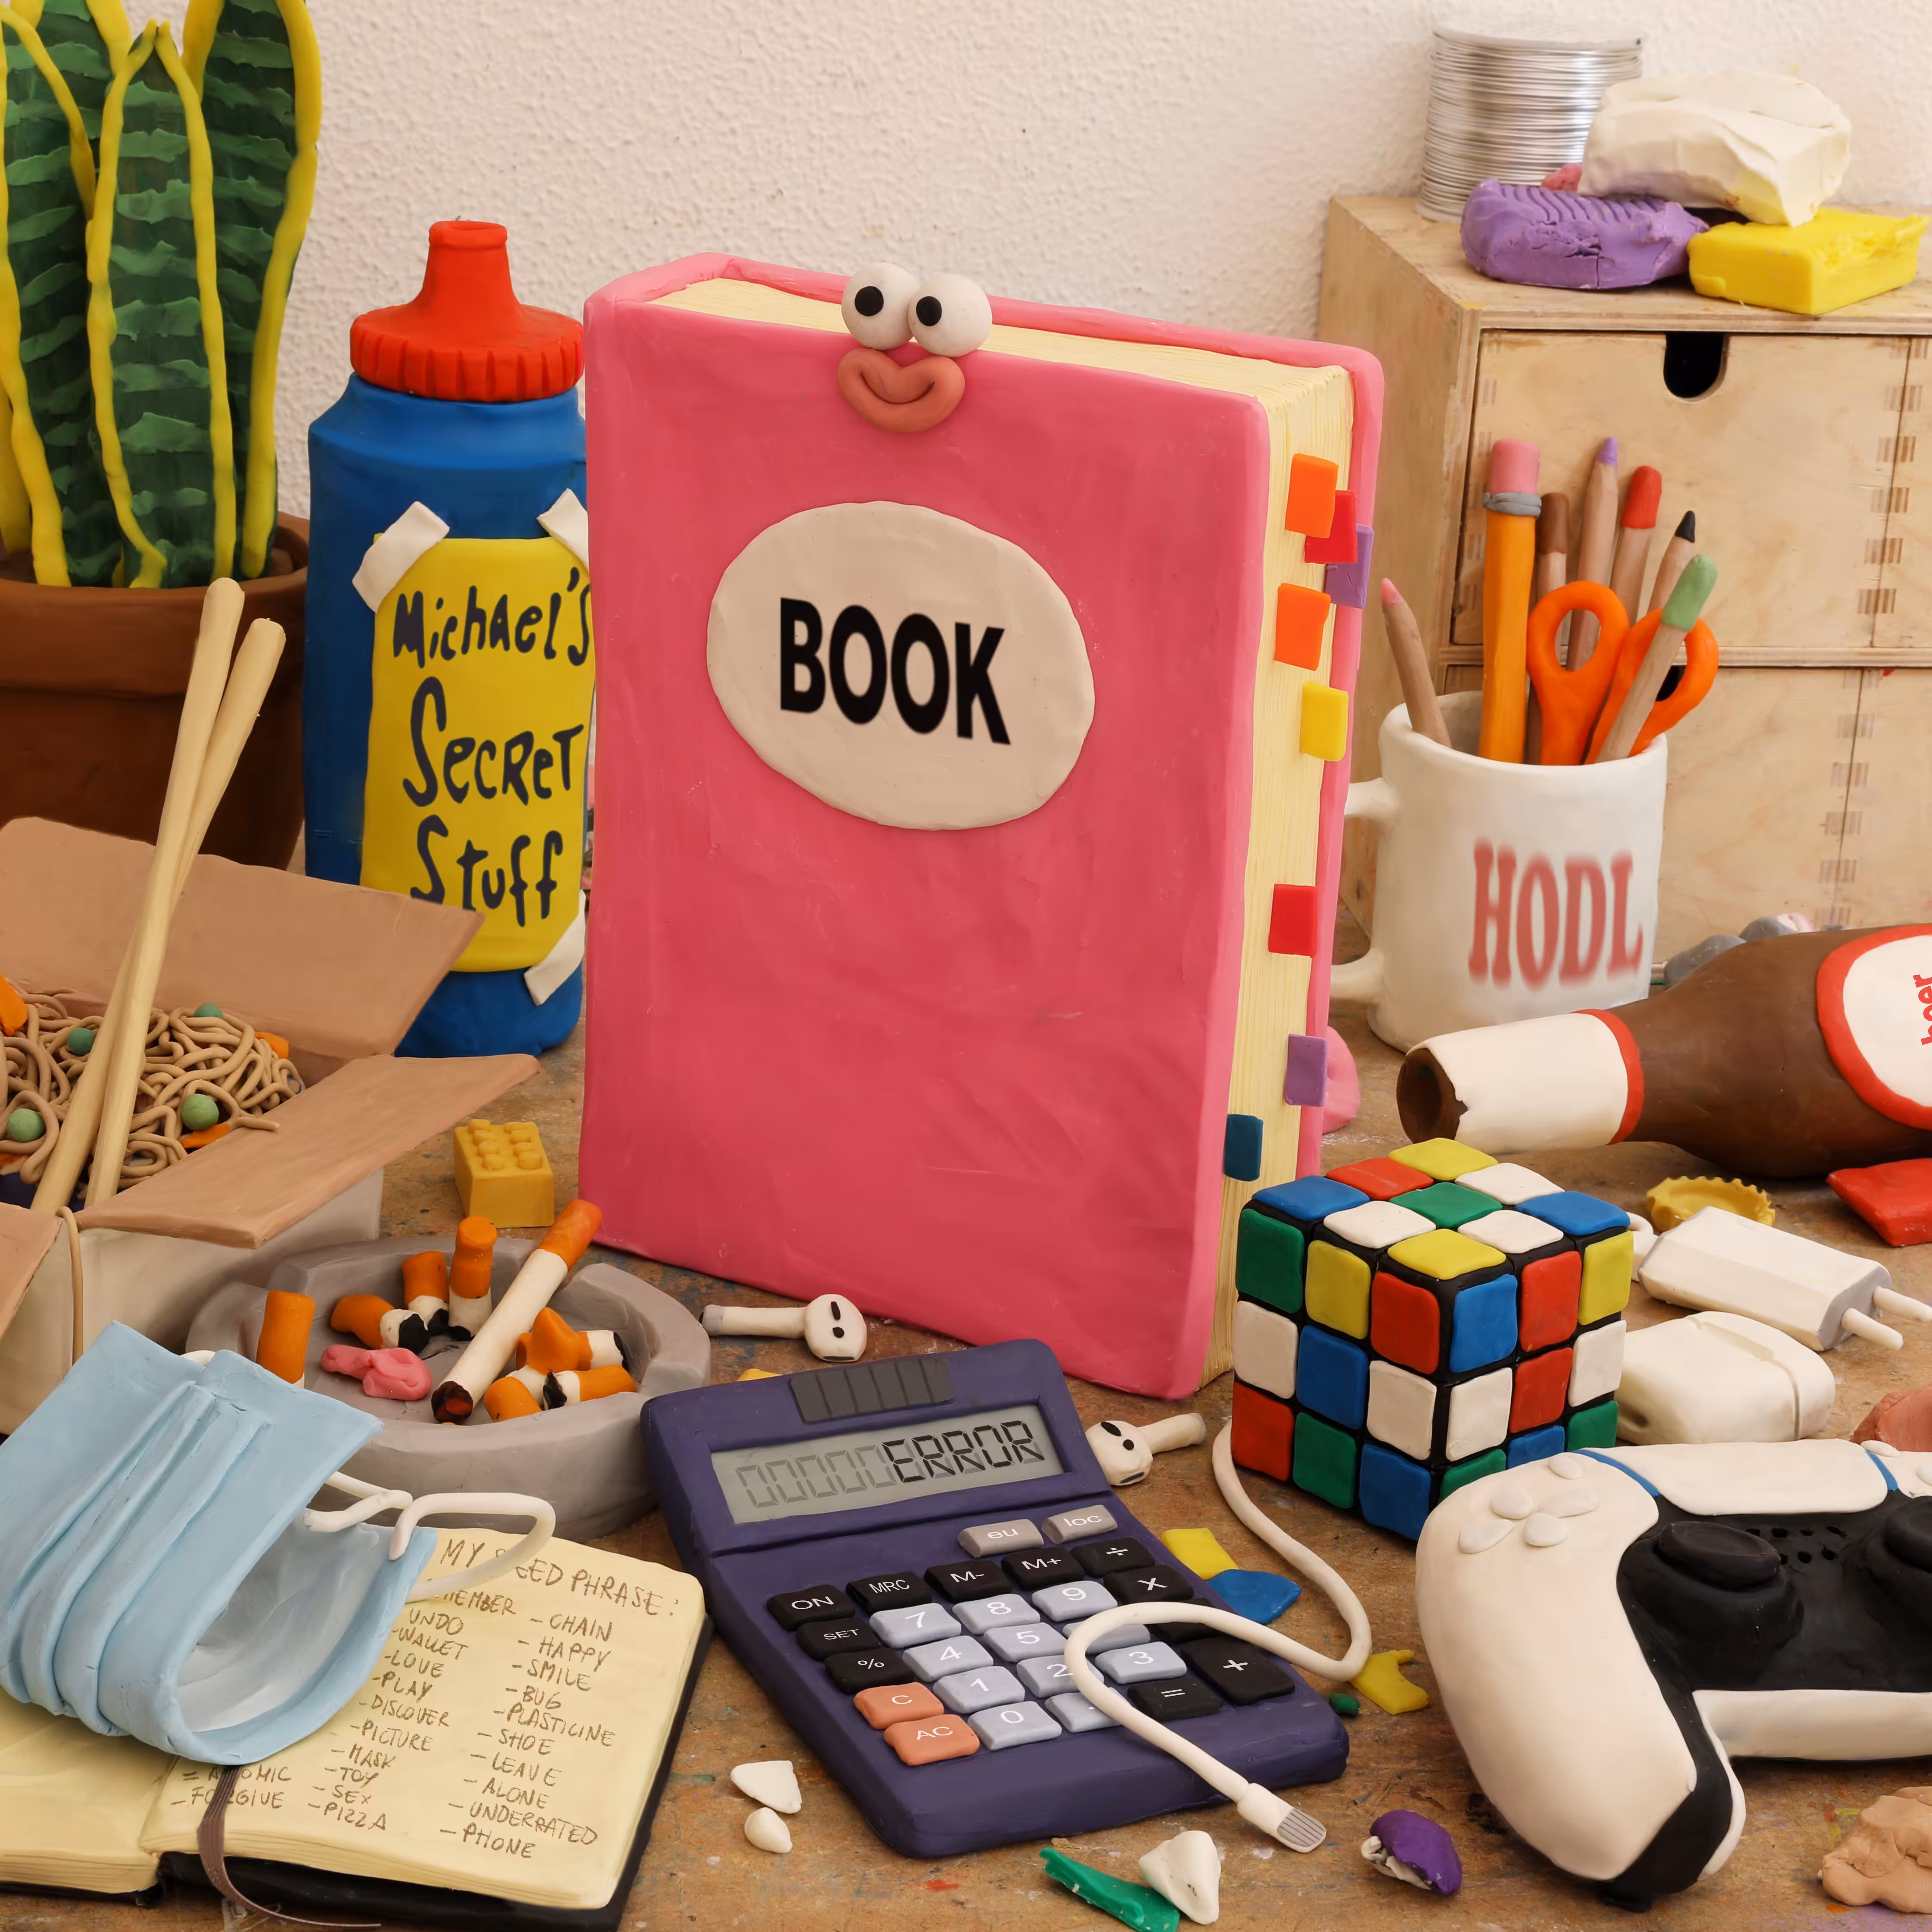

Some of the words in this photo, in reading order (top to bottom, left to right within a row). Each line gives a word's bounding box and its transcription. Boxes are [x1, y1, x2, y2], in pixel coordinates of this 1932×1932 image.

[780, 597, 1010, 745] BOOK
[410, 814, 562, 927] Stuff
[1468, 835, 1643, 992] HODL
[882, 1420, 1044, 1483] ERROR
[1063, 1515, 1101, 1527] loc
[988, 1528, 1018, 1539] eu
[440, 1538, 485, 1568] MY
[1021, 1558, 1061, 1570] M+
[950, 1571, 985, 1582] M-
[869, 1580, 910, 1593] MRC
[1062, 1588, 1086, 1600] 9
[791, 1596, 834, 1609] ON
[989, 1602, 1011, 1615] 8
[409, 1608, 464, 1635] UNDO
[905, 1612, 926, 1628] 7
[824, 1629, 859, 1640] SET
[1016, 1631, 1040, 1644] 5
[940, 1646, 963, 1661] 4
[1129, 1651, 1154, 1664] 3
[858, 1659, 884, 1669] %
[1225, 1659, 1249, 1672] +
[1047, 1664, 1073, 1678] 2
[970, 1678, 990, 1692] 1
[891, 1694, 912, 1705] C
[1000, 1711, 1024, 1723] 0
[916, 1726, 953, 1741] AC
[208, 1764, 292, 1783] AOMIC
